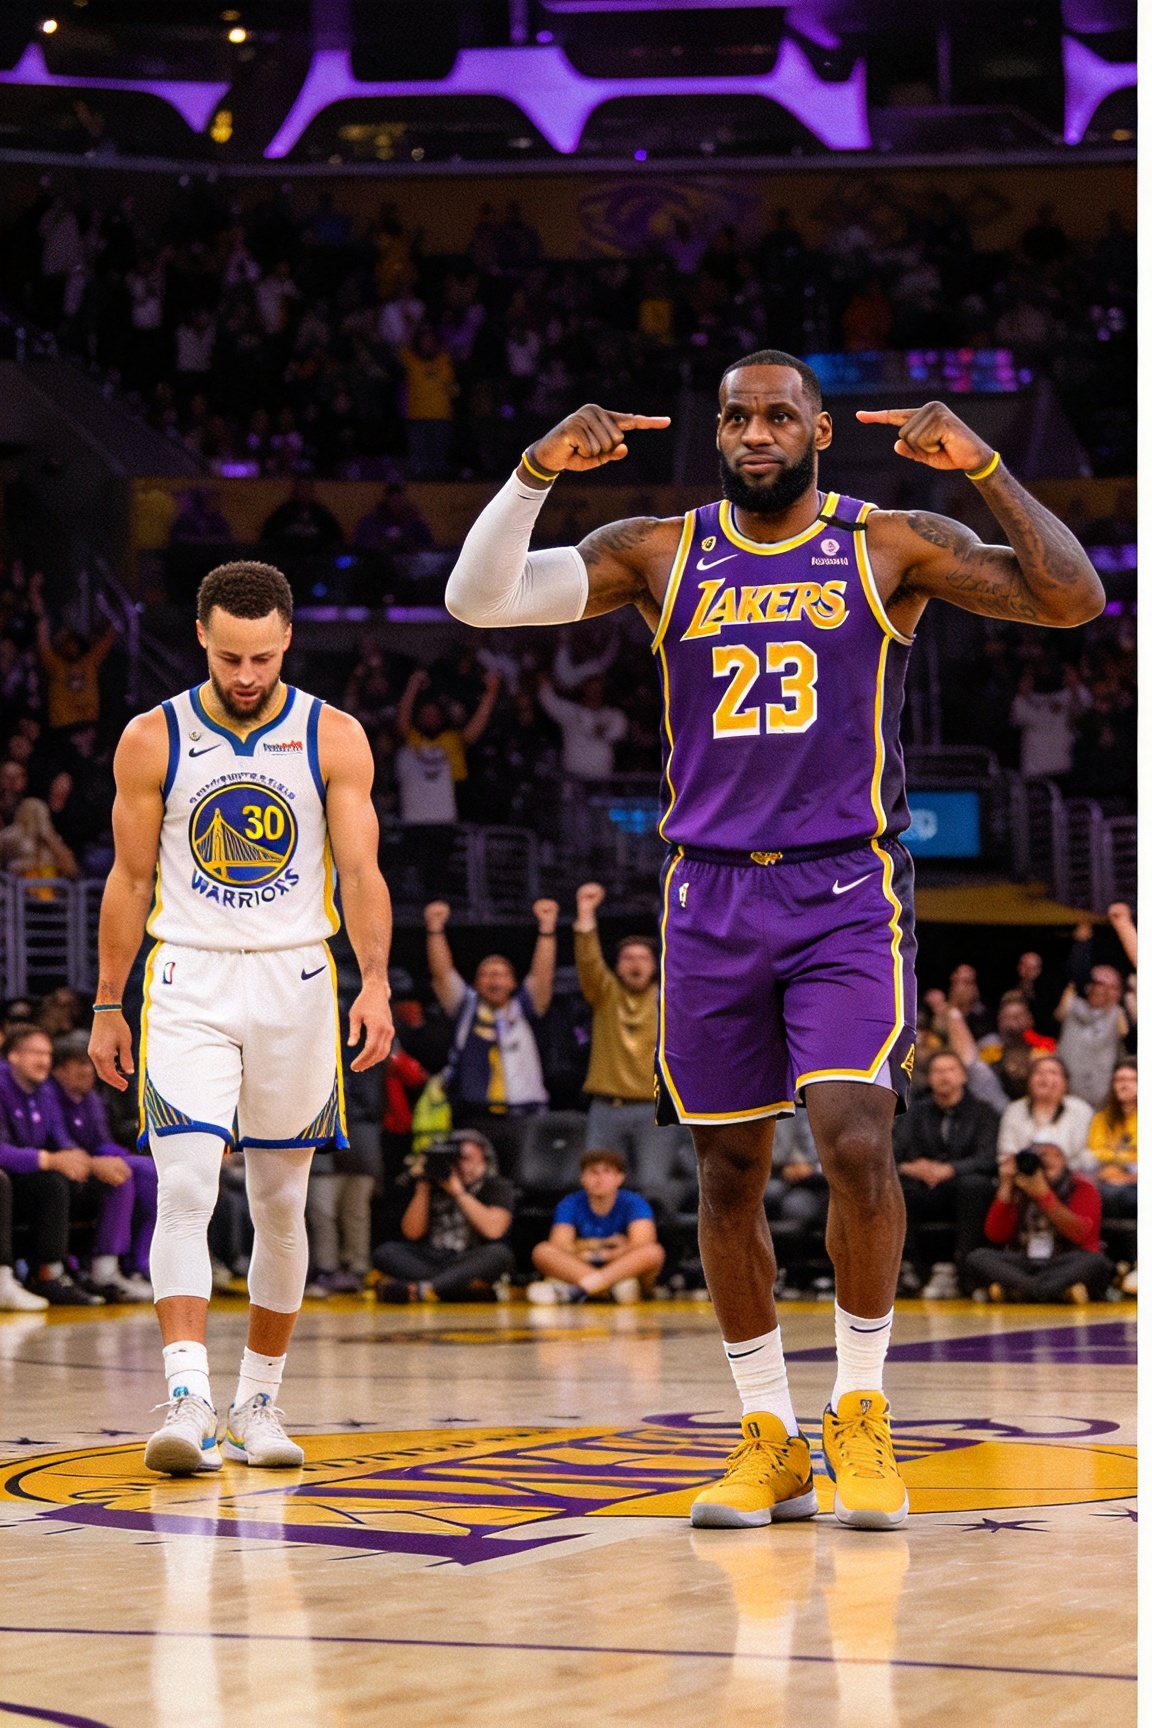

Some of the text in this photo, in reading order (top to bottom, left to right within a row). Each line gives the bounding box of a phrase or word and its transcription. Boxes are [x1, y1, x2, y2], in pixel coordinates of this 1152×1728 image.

[680, 577, 850, 642] LAKERS
[712, 640, 818, 739] 23
[242, 805, 285, 840] 30
[191, 867, 299, 909] WARRIORS
